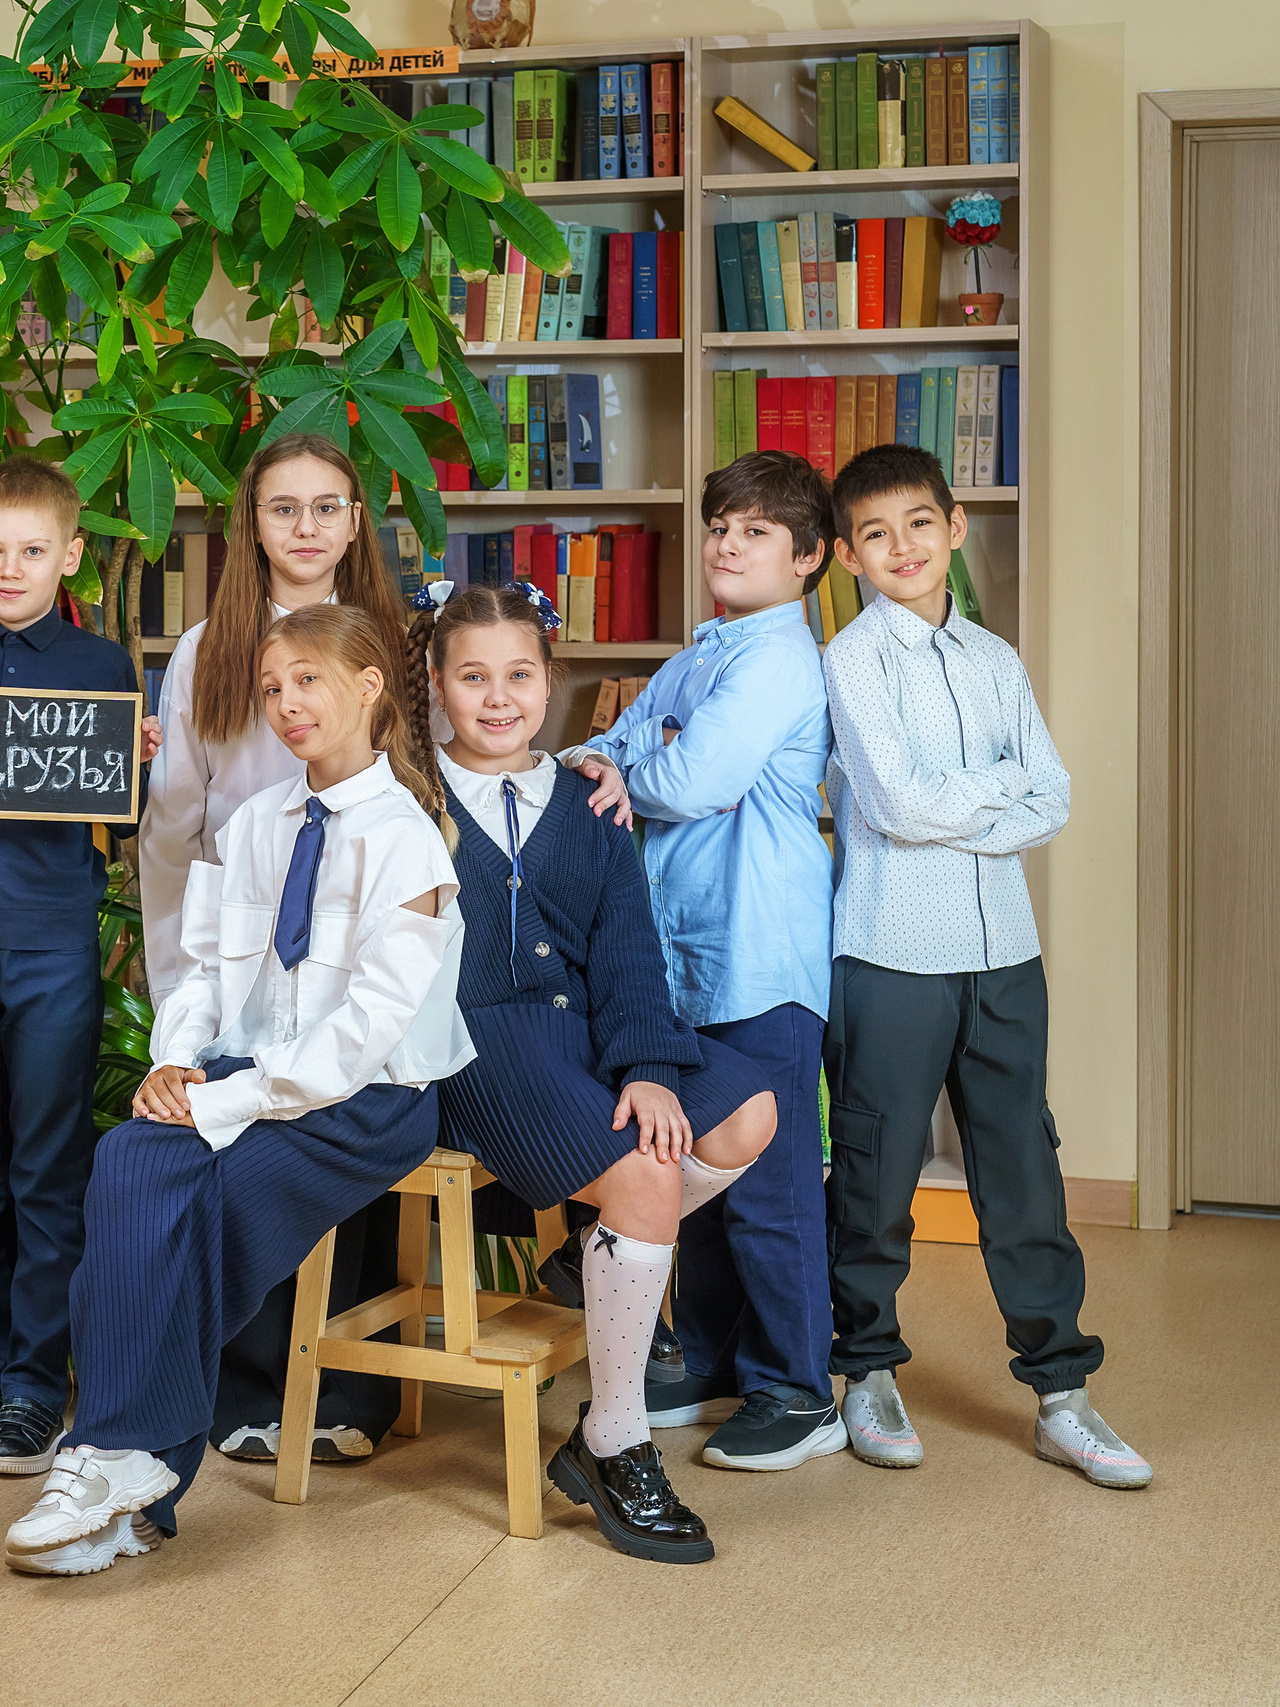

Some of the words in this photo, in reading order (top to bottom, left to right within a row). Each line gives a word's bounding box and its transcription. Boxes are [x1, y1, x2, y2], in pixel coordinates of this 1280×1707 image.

[348, 57, 384, 73] ДЛЯ
[389, 50, 444, 72] ДЕТЕЙ
[5, 699, 98, 737] МОИ
